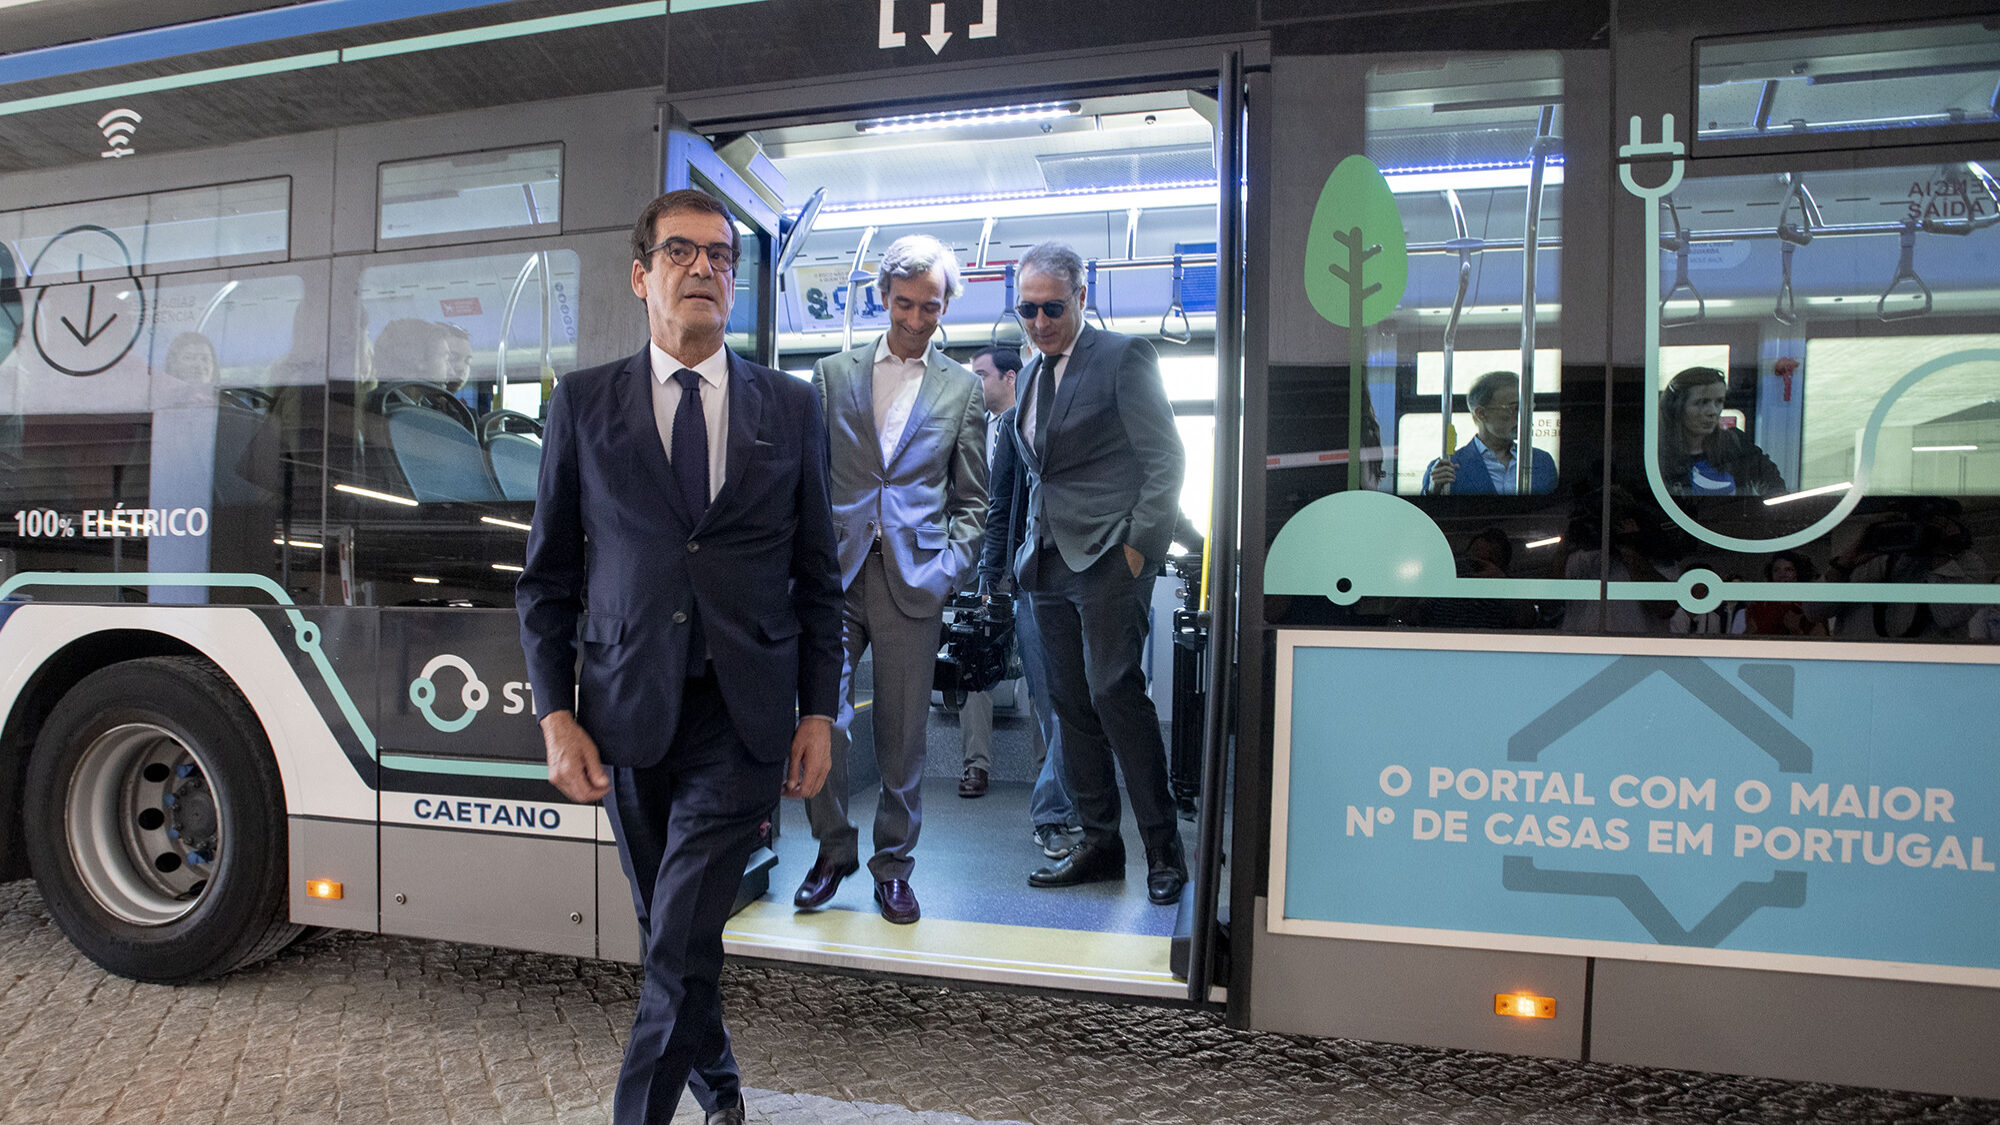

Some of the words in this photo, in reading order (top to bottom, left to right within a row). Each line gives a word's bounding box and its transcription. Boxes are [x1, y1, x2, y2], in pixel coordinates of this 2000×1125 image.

[14, 509, 75, 537] 100%
[82, 502, 209, 537] ELÉTRICO
[414, 798, 561, 830] CAETANO
[1379, 765, 1412, 797] O
[1428, 766, 1595, 805] PORTAL
[1609, 774, 1717, 811] COM
[1734, 779, 1771, 813] O
[1790, 782, 1955, 823] MAIOR
[1412, 808, 1468, 842] DE
[1484, 812, 1631, 851] CASAS
[1648, 820, 1713, 856] EM
[1734, 824, 1996, 872] PORTUGAL
